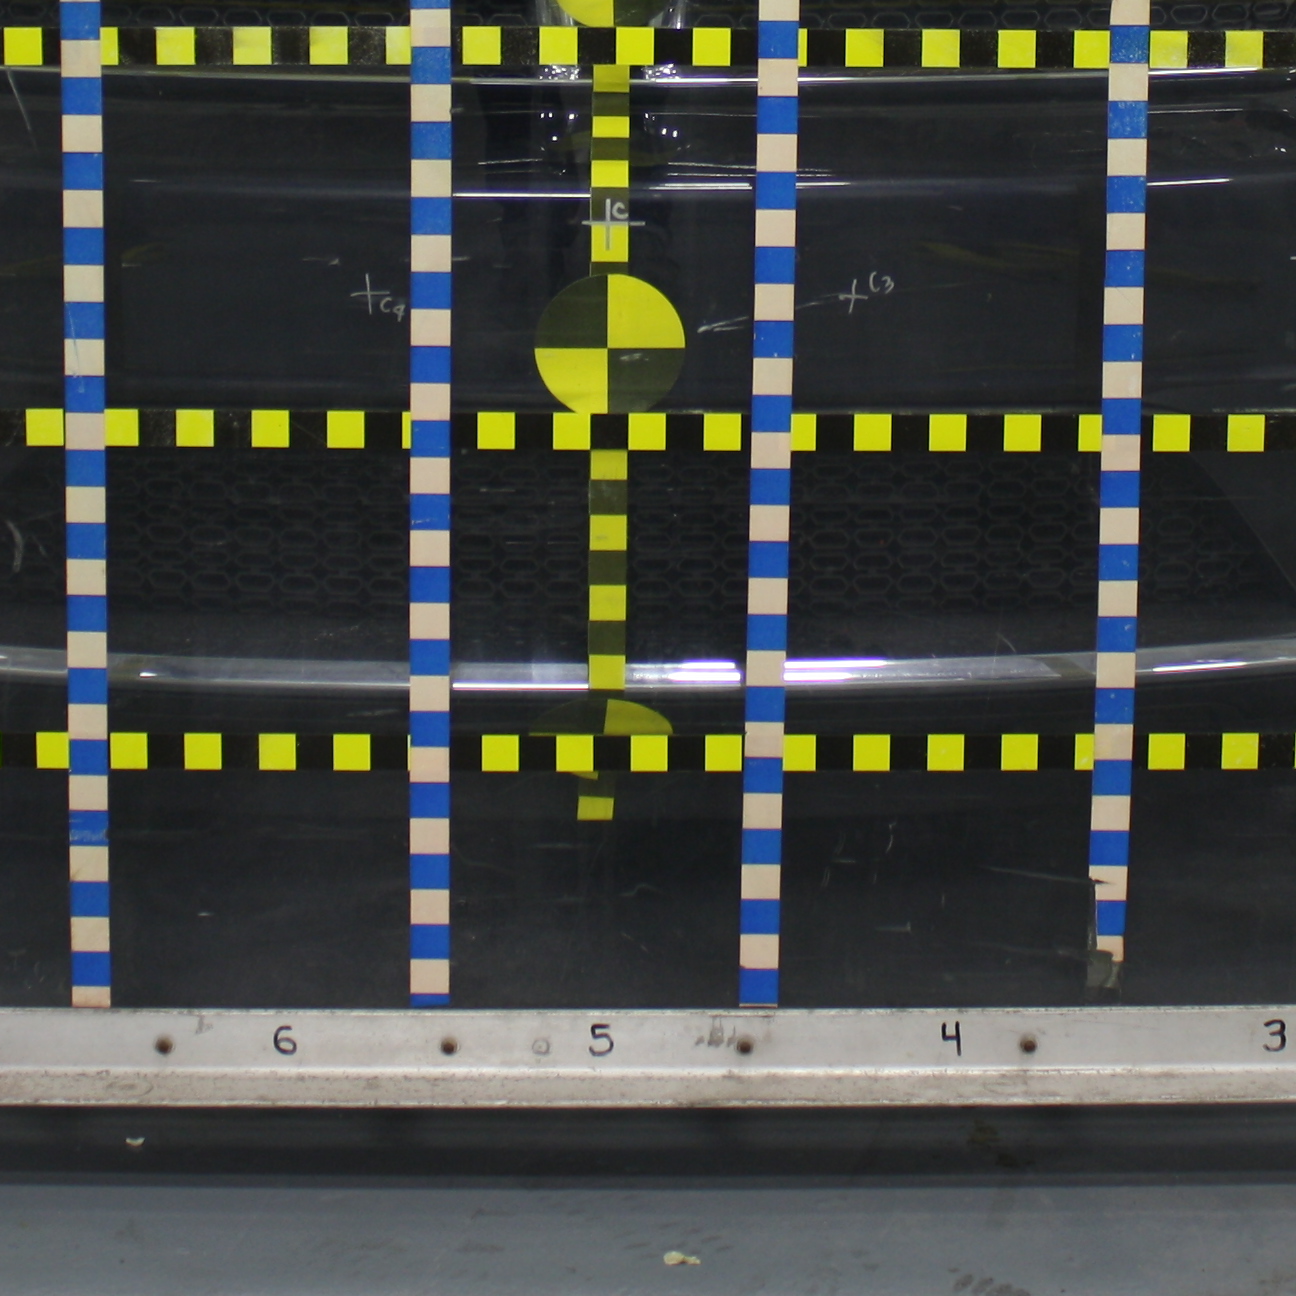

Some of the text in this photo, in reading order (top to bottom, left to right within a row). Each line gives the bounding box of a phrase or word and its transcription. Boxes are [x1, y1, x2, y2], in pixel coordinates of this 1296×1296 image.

[272, 1025, 298, 1056] 6
[588, 1023, 615, 1057] 5
[940, 1020, 962, 1057] 4
[1262, 1018, 1288, 1052] 3
